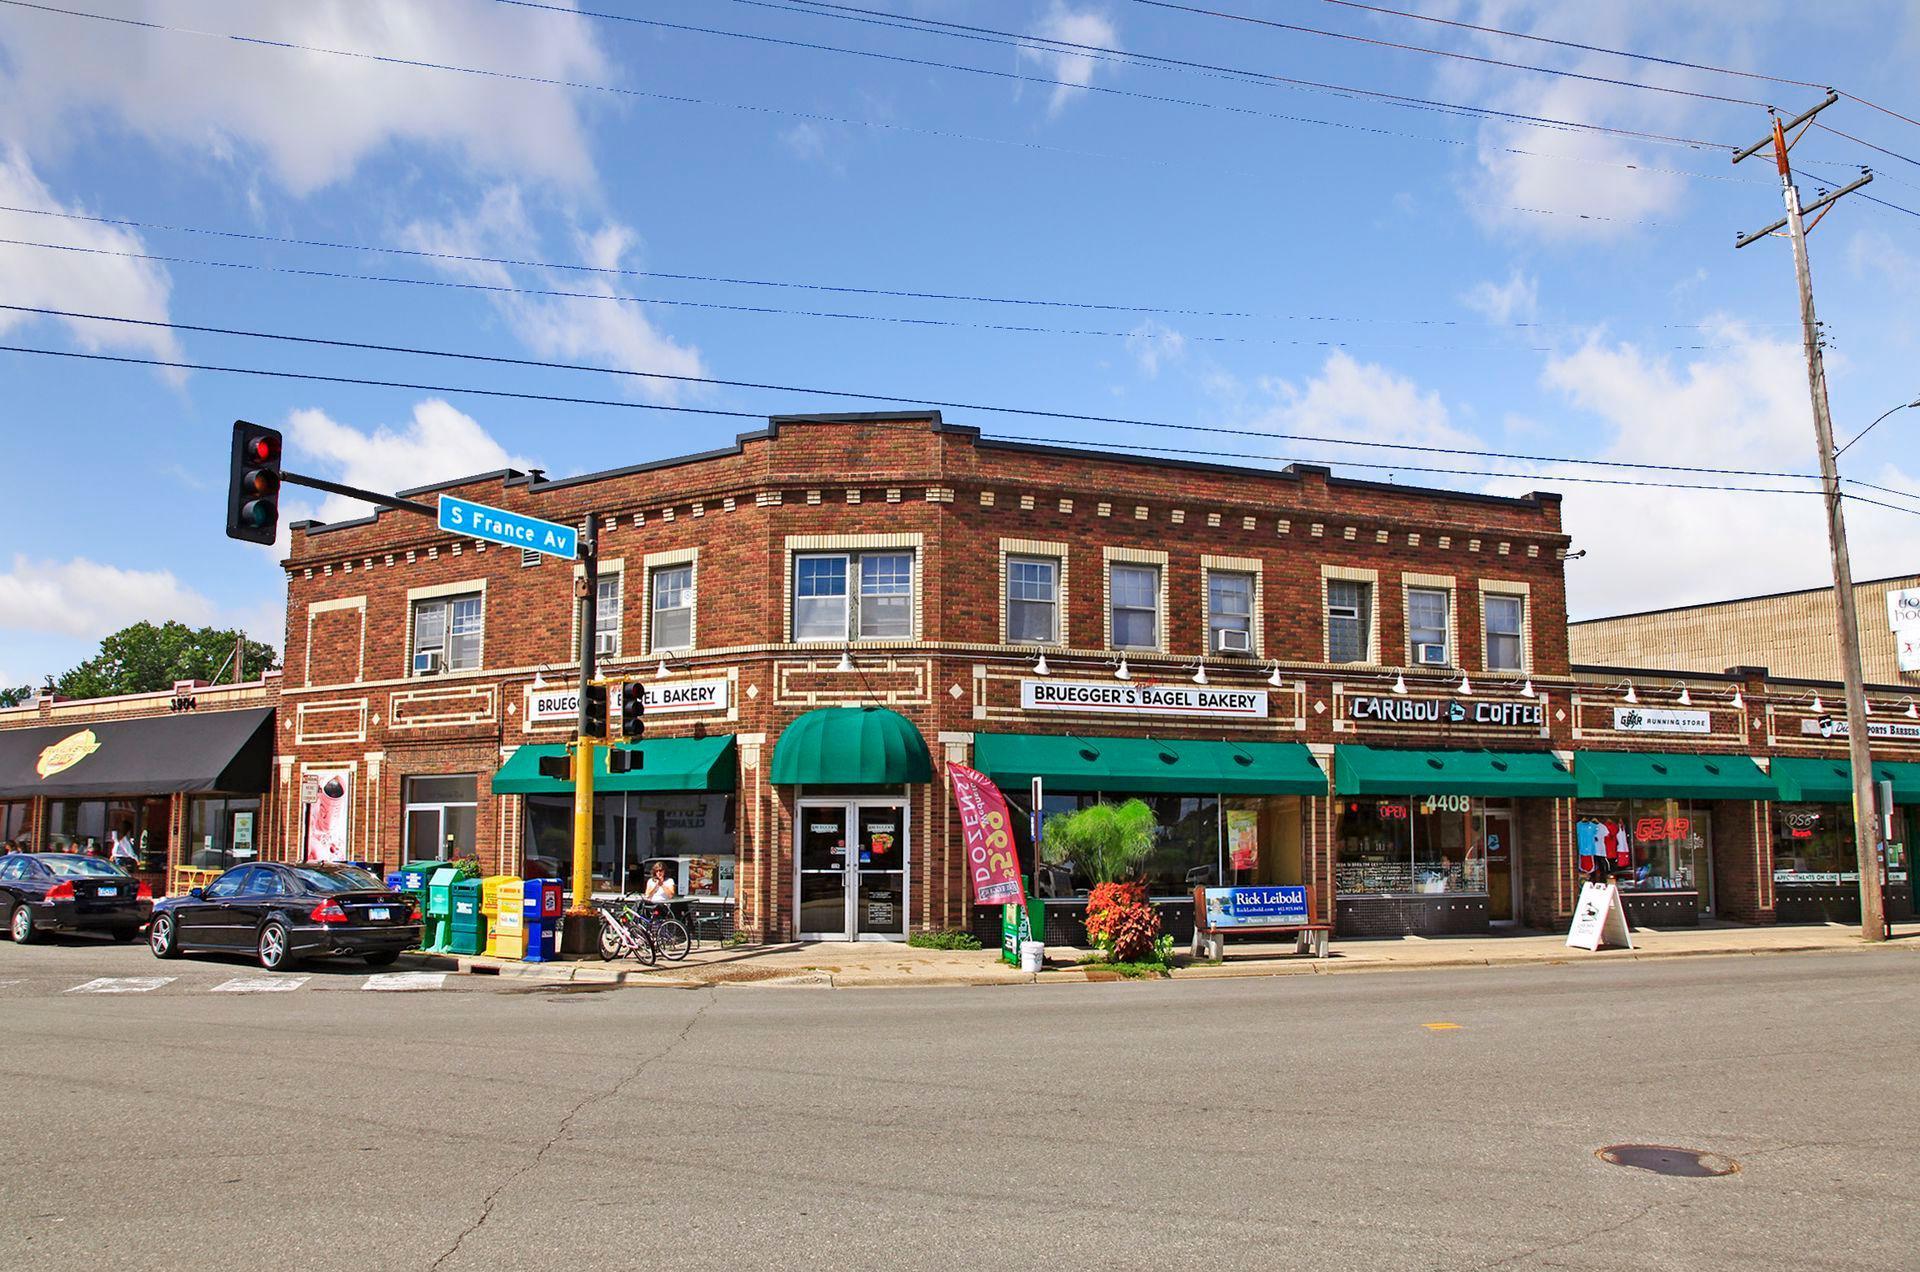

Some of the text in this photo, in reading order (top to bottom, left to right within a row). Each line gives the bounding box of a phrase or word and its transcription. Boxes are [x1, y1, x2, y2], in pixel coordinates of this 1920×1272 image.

[451, 506, 567, 549] S France Av
[663, 686, 716, 704] BAKERY
[1034, 686, 1257, 708] BRUEGGER'S BAGEL BAKERY
[1352, 697, 1544, 725] CARIBOU COFFEE
[1646, 718, 1680, 726] RUNNING
[1682, 719, 1705, 727] STORE
[1835, 722, 1920, 736] Dic PORTS BARBERS
[1426, 794, 1470, 812] 4408
[1380, 806, 1407, 819] OPEN
[1636, 817, 1690, 841] GEAR
[1236, 891, 1303, 905] Rick Leibold
